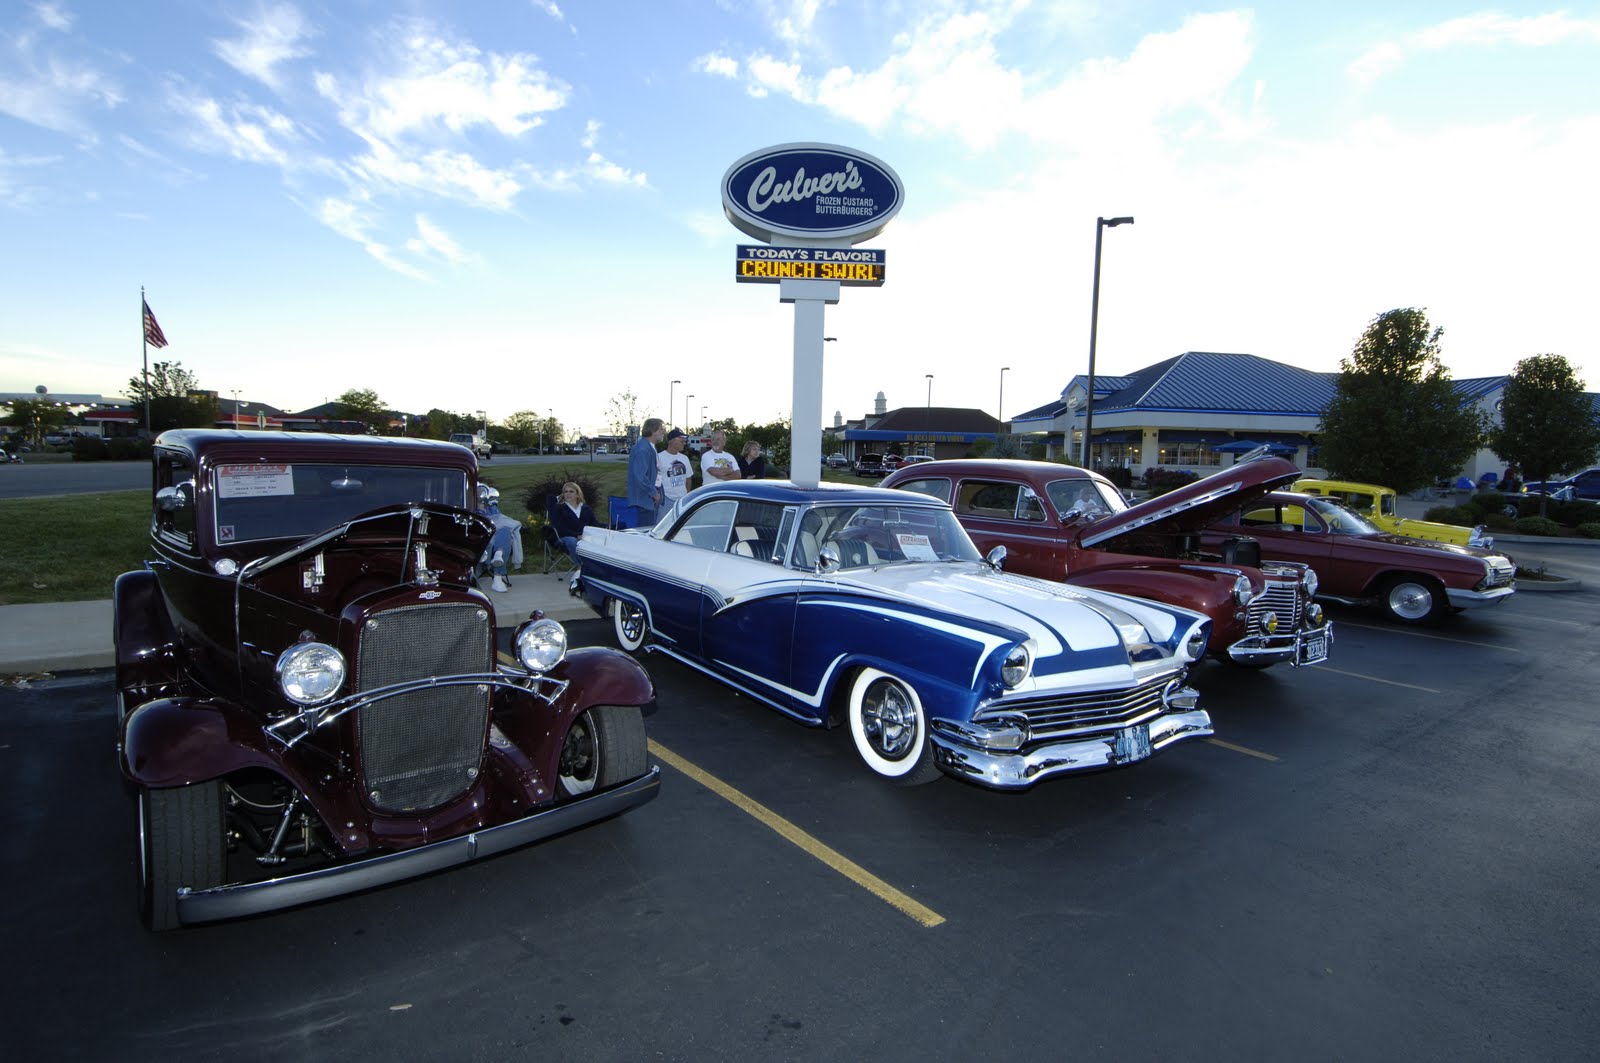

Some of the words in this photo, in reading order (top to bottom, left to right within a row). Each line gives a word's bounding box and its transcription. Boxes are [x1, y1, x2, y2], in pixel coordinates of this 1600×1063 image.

[747, 160, 863, 212] Culver's
[816, 195, 841, 206] FROZEN
[842, 196, 874, 207] CUSTARD
[746, 248, 809, 260] TODAY'S
[814, 250, 877, 262] FLAVOR!
[742, 260, 816, 278] CRUNCH
[821, 262, 877, 280] SWIRL
